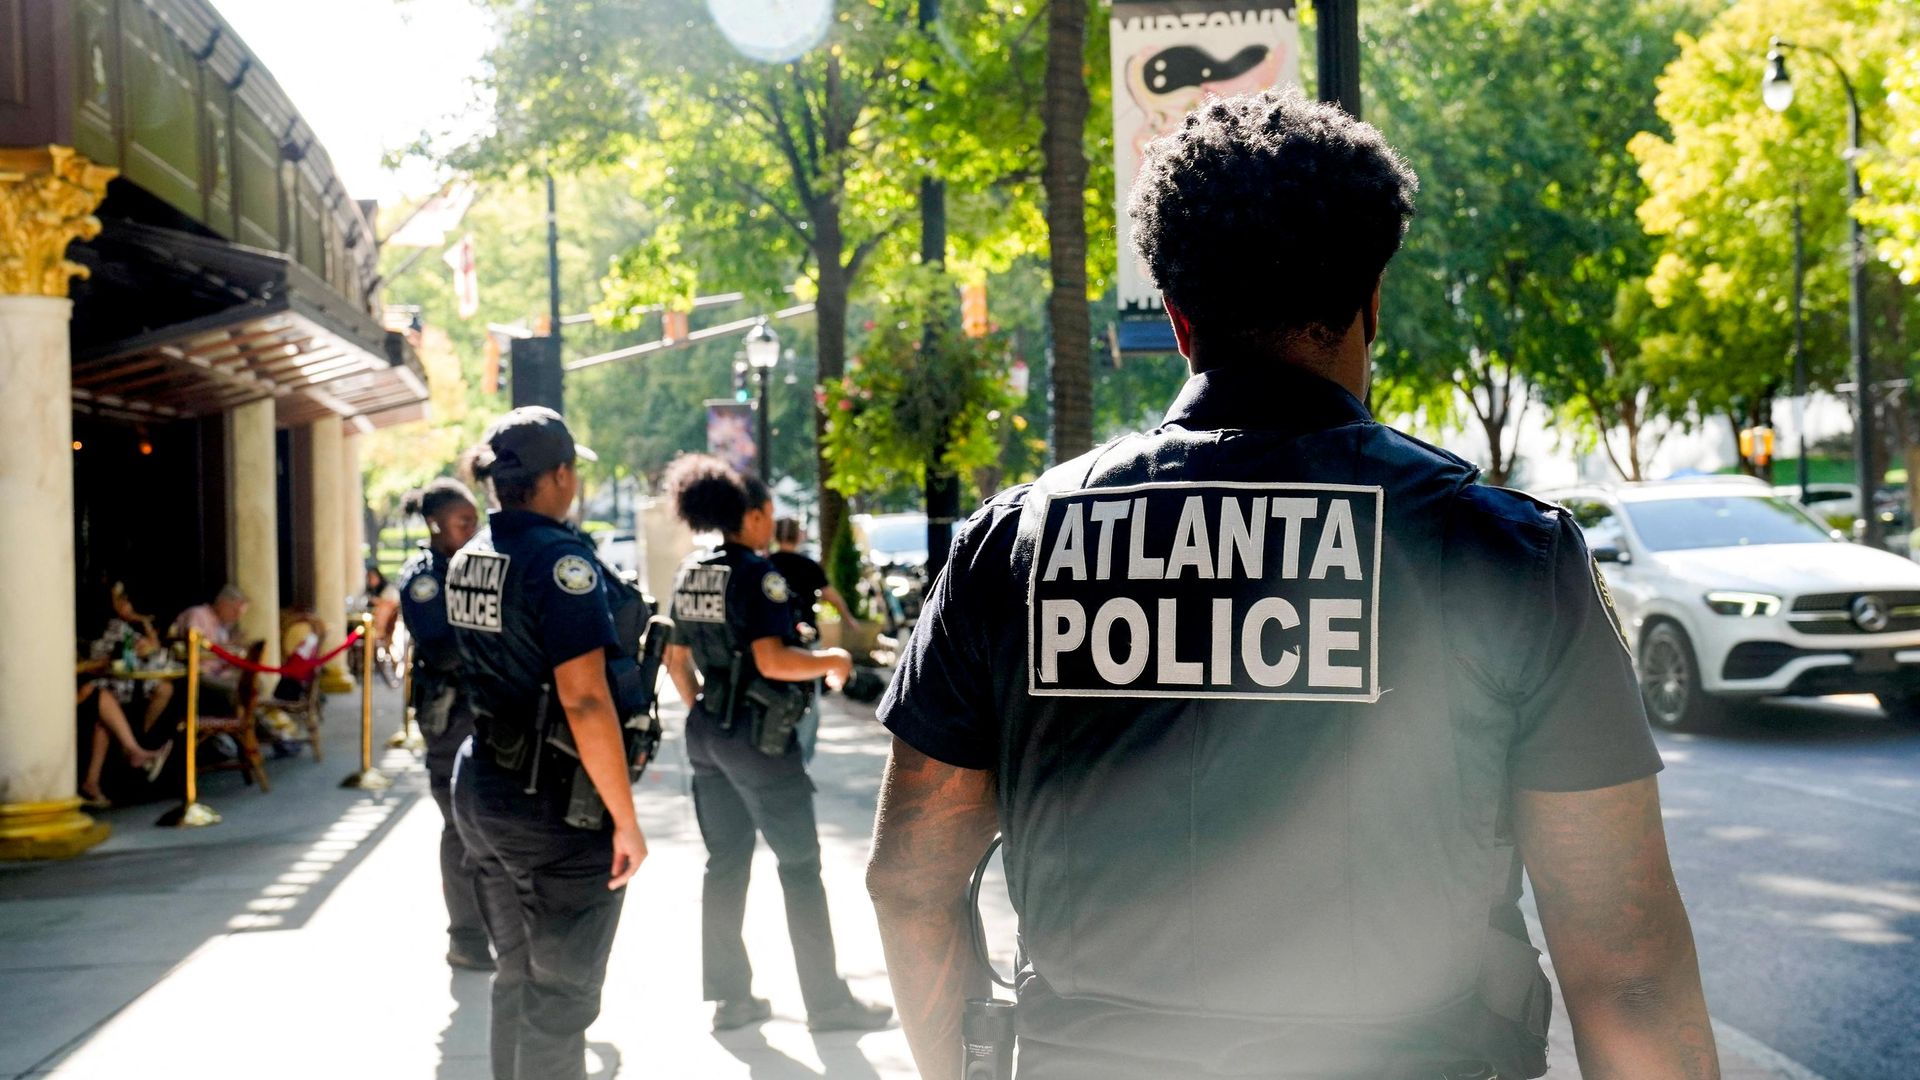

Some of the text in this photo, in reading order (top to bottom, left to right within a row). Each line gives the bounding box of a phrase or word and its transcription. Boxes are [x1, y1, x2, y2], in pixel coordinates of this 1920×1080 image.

[1042, 495, 1363, 582] ATLANTA
[448, 588, 498, 627] POLICE
[676, 593, 723, 617] POLICE
[1041, 596, 1363, 688] POLICE
